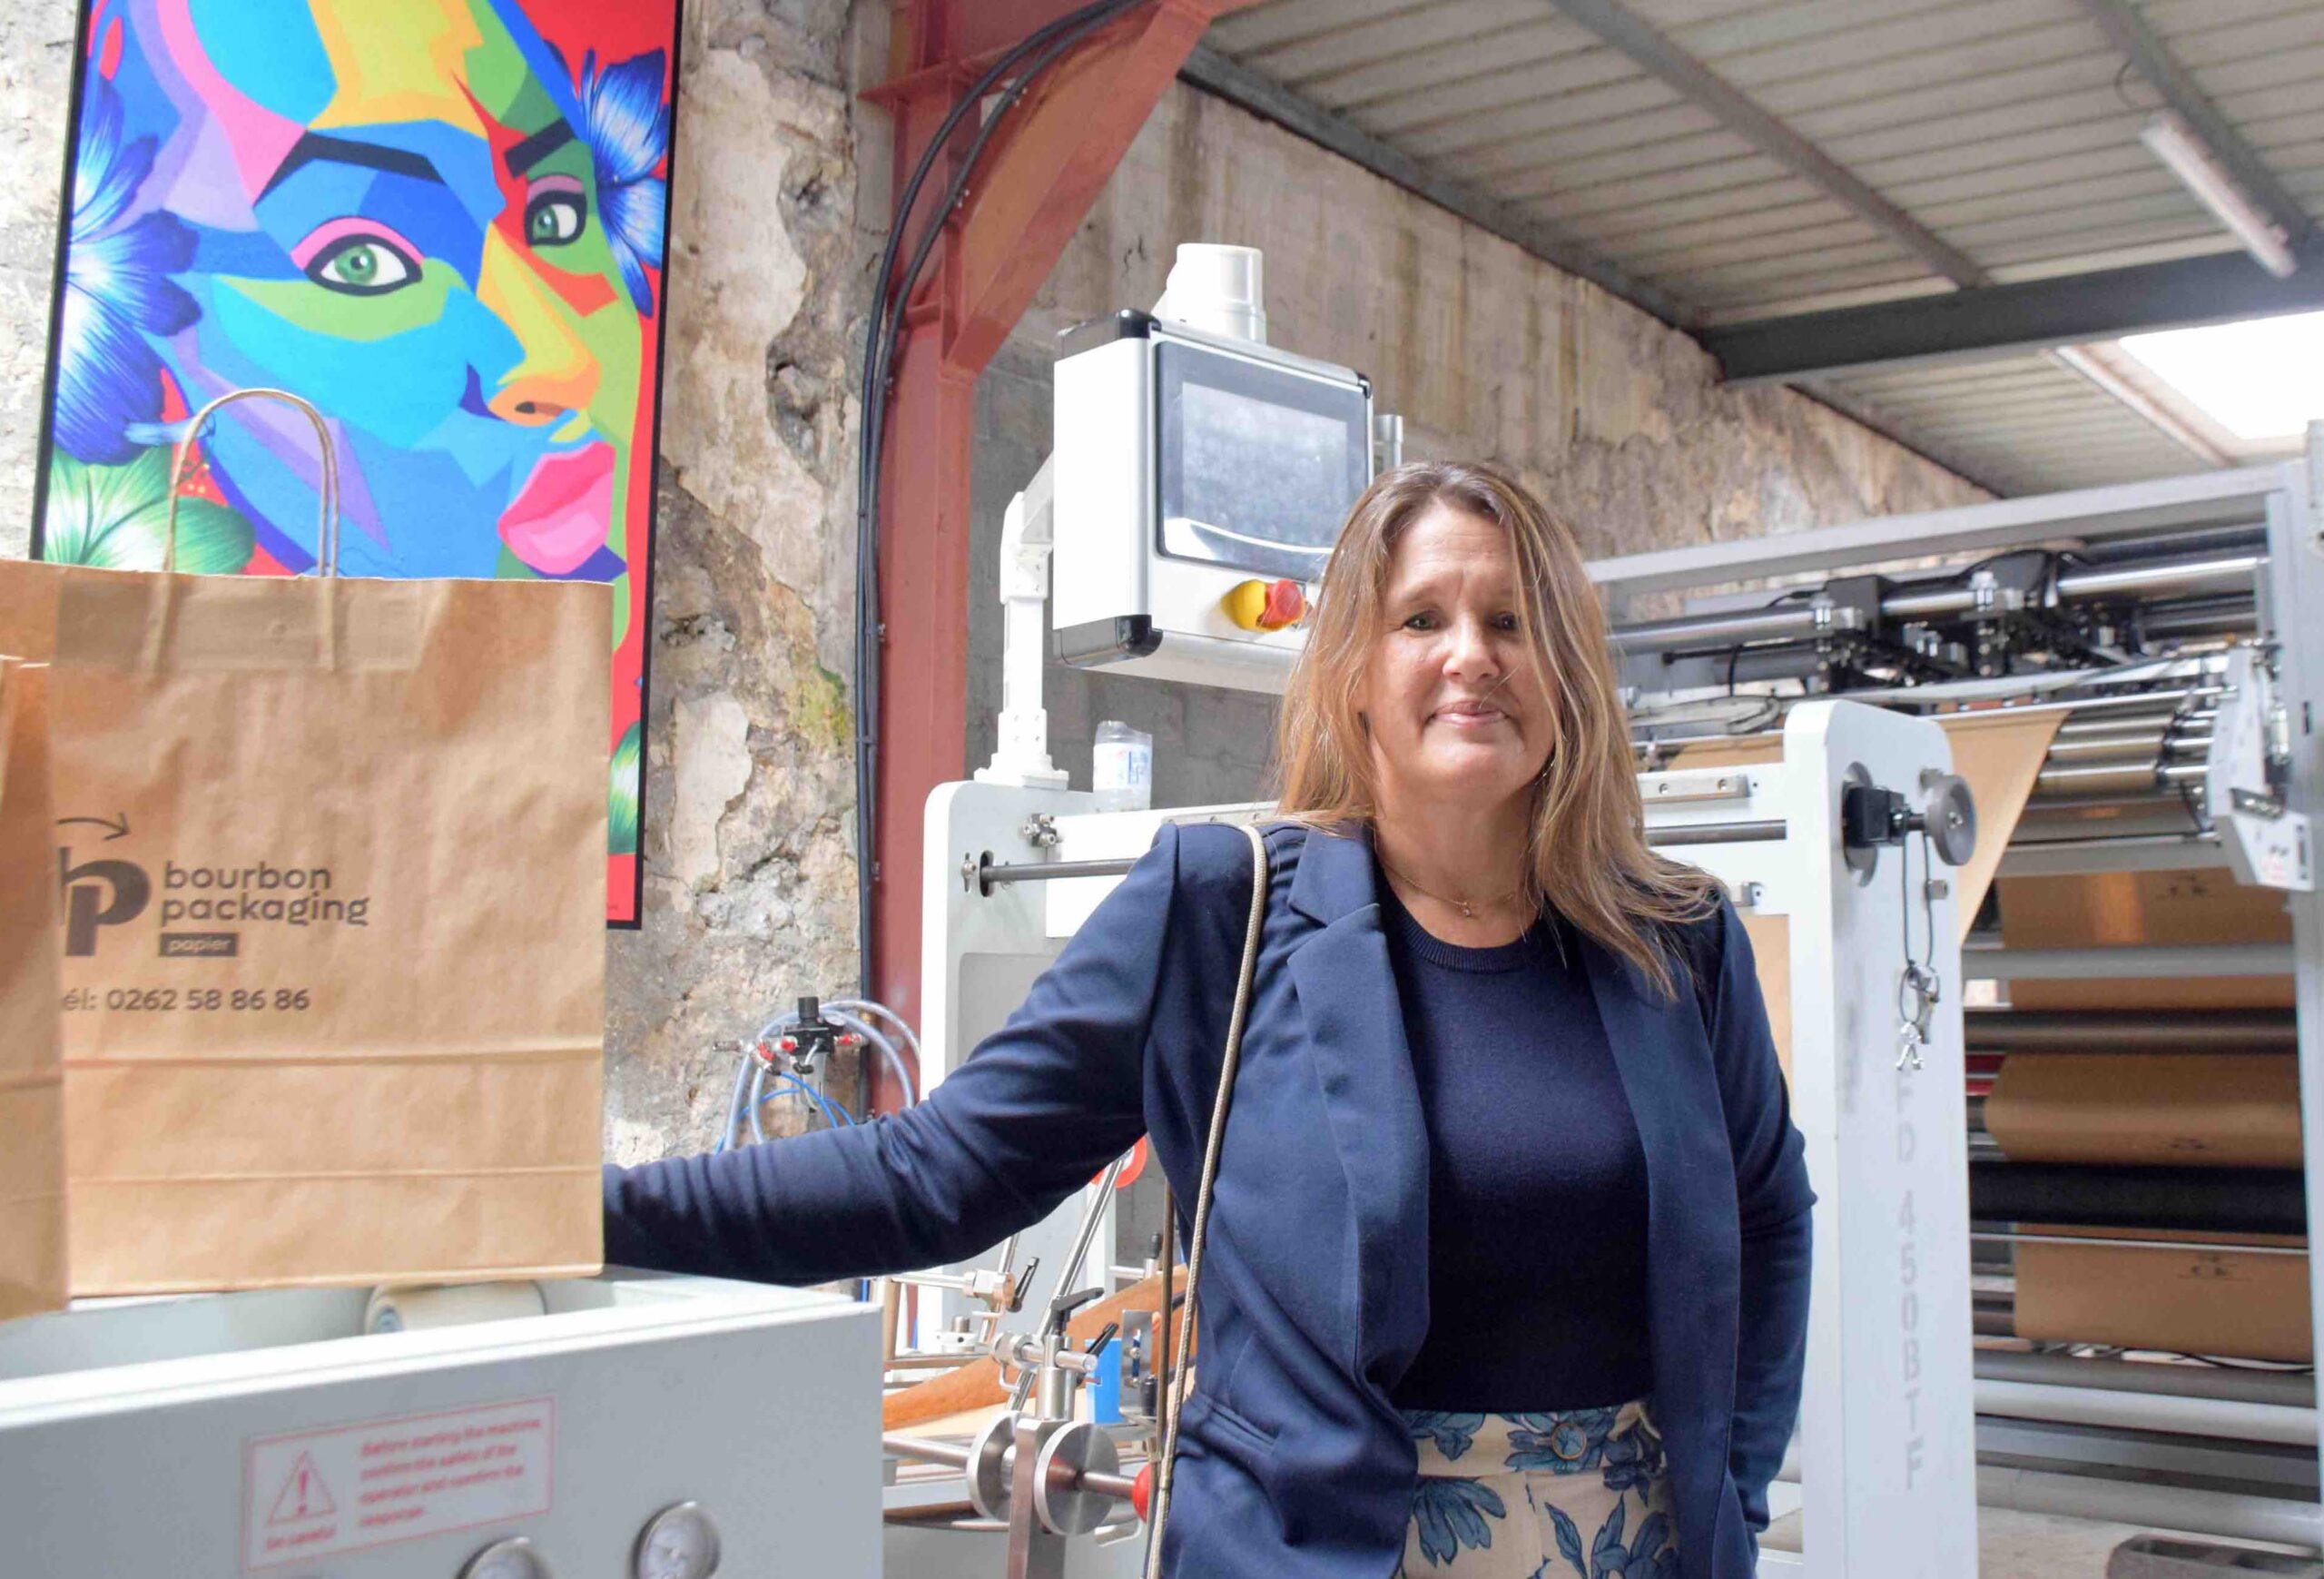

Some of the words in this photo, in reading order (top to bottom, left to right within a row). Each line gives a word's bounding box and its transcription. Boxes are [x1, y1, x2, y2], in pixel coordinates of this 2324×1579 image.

[164, 861, 331, 889] bourbon
[161, 891, 370, 927] packaging
[168, 935, 231, 953] papier
[61, 988, 96, 1011] él:
[106, 988, 178, 1011] 0262
[186, 988, 222, 1011] 58
[230, 988, 266, 1011] 86
[274, 988, 310, 1011] 86
